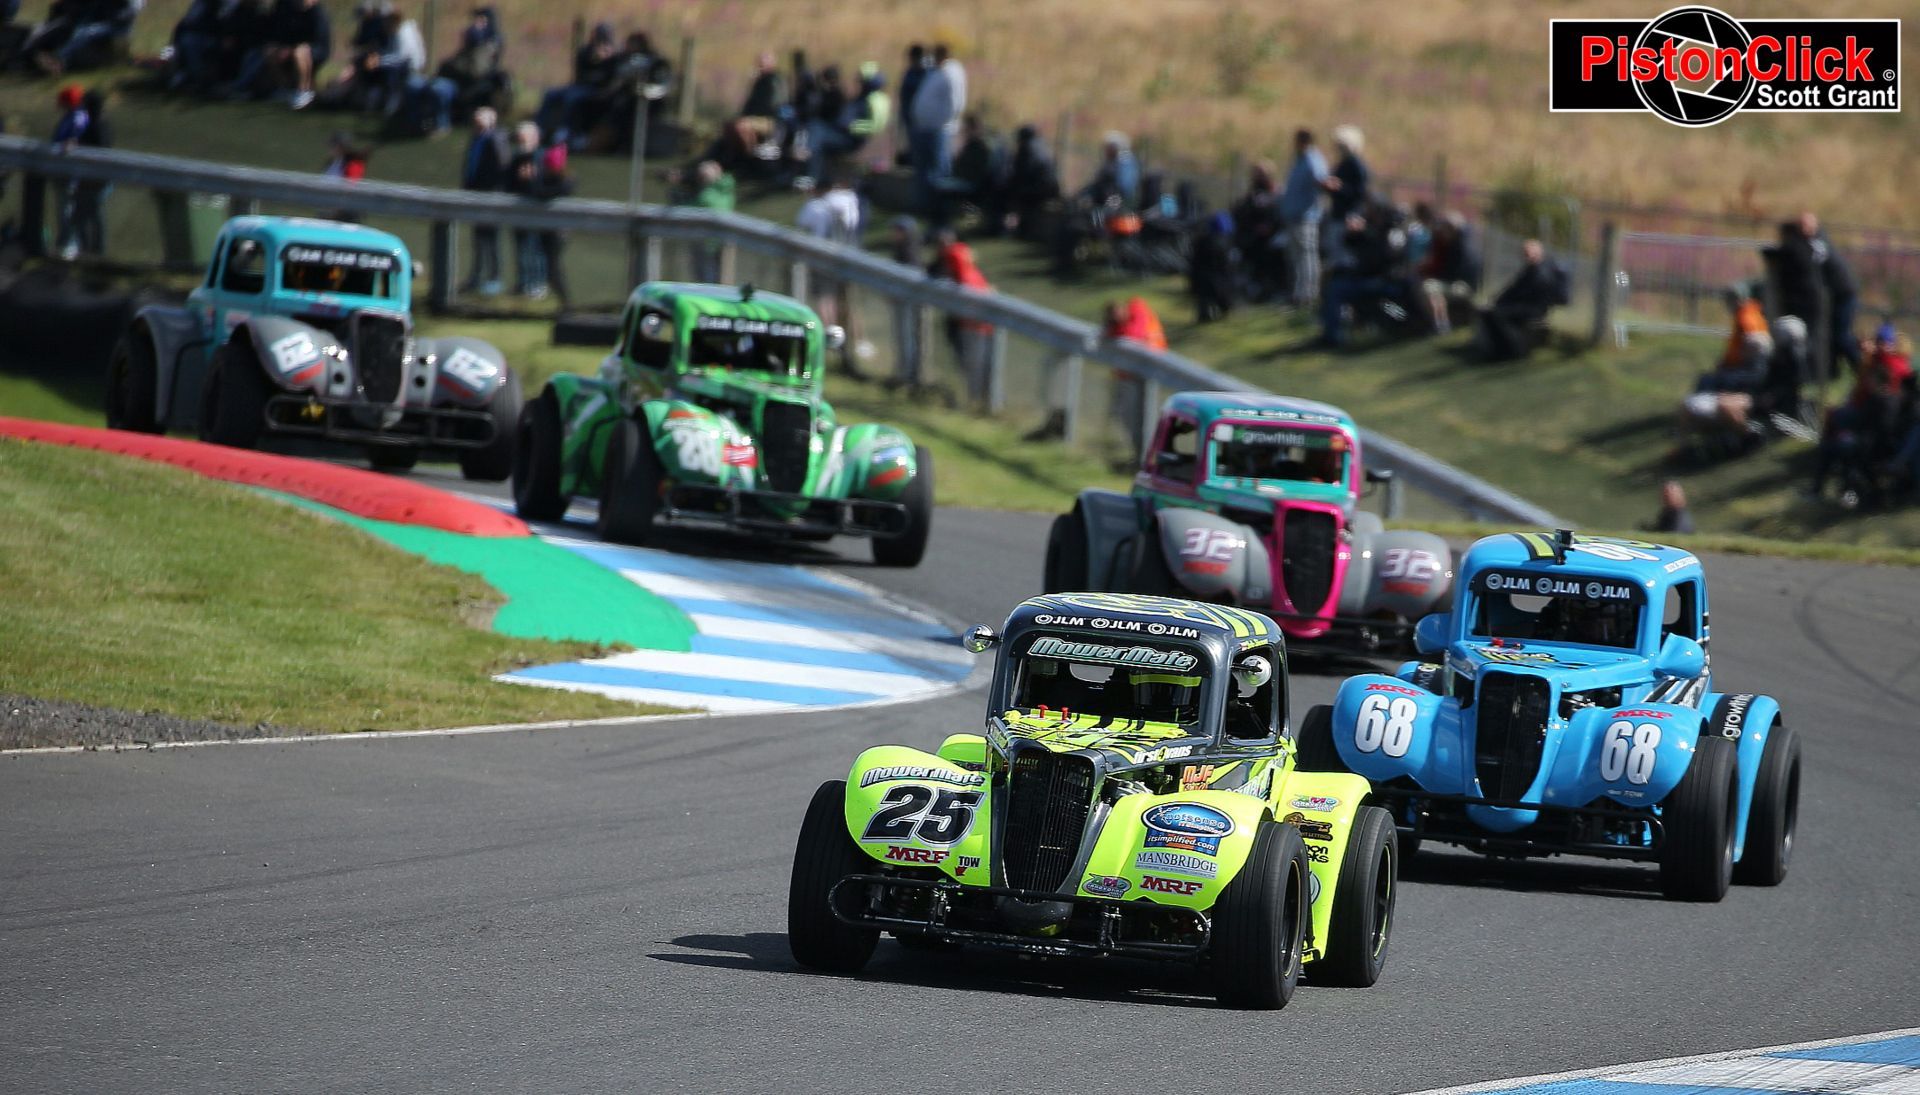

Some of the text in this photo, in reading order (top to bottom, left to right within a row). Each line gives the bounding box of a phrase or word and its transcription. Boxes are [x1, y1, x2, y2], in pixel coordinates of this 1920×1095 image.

[1180, 527, 1233, 561] 32
[1380, 548, 1435, 579] 32
[1501, 577, 1630, 599] JLM JLM JLM
[1052, 616, 1198, 638] JLM JLM JLM
[1031, 638, 1197, 669] MowerMate
[1364, 683, 1425, 697] MRF
[1612, 709, 1673, 719] MRF
[1355, 693, 1418, 758] 68
[1601, 720, 1662, 785] 68
[860, 766, 985, 786] MowerMate
[861, 784, 987, 848] 25
[1147, 834, 1215, 851] itsimplified.com
[885, 846, 949, 864] MRF
[958, 855, 981, 868] TOW
[1136, 852, 1217, 873] MANSBRIDGE
[1140, 875, 1202, 895] MRF
